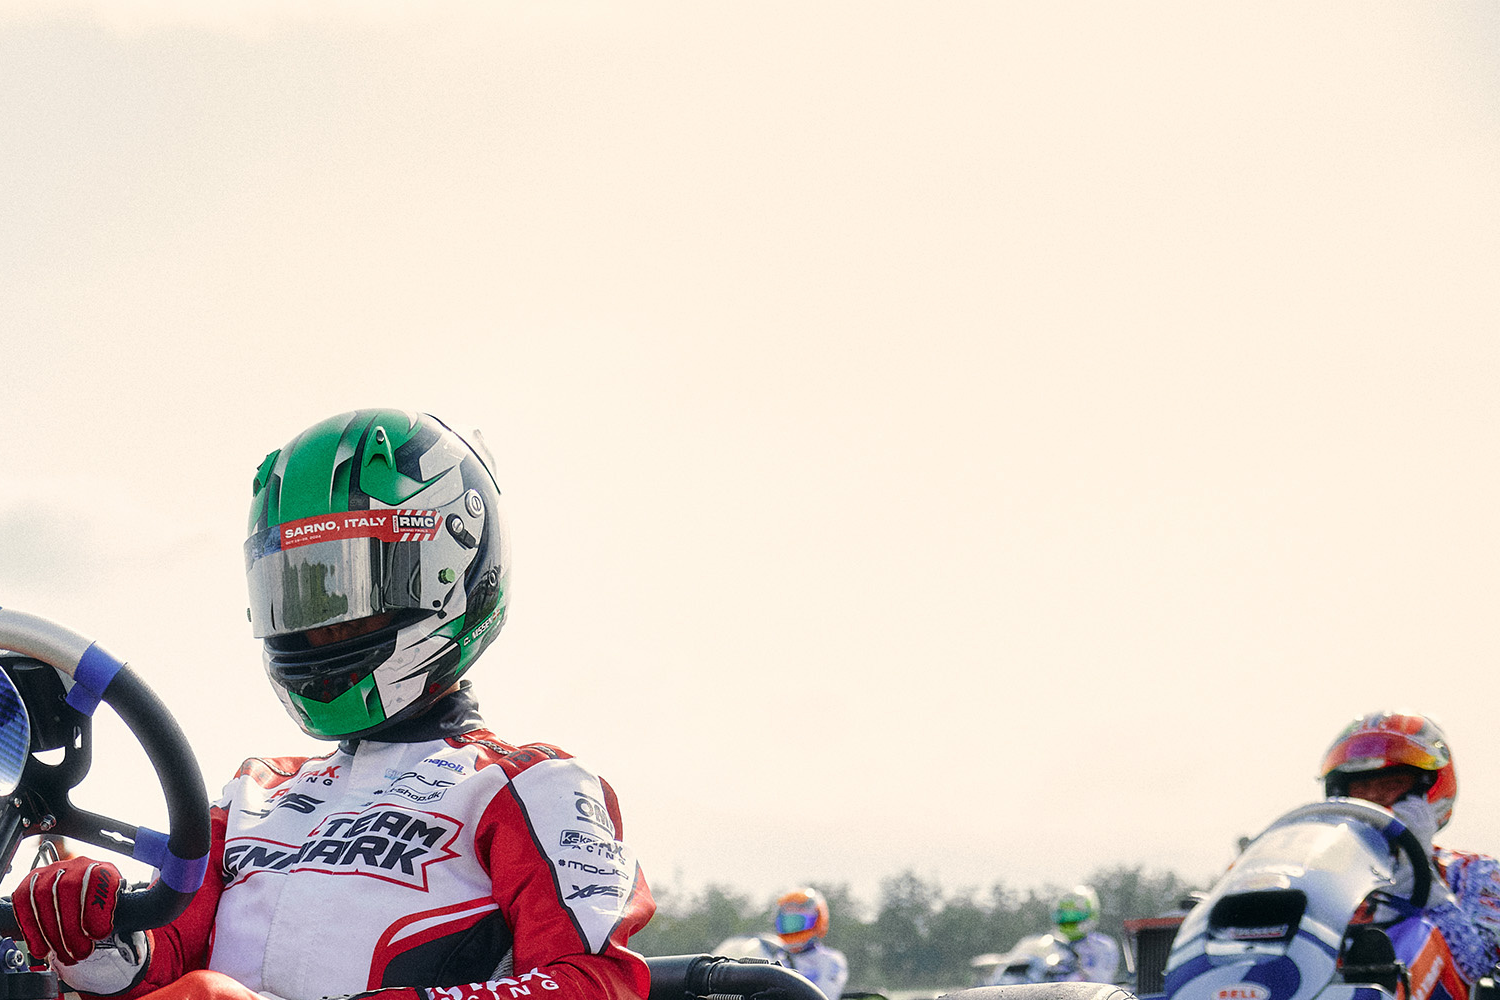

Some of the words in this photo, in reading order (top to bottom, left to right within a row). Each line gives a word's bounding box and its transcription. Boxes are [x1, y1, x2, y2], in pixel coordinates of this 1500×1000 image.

[285, 520, 341, 539] SARNO,
[344, 517, 387, 529] ITALY
[399, 516, 435, 528] RMC
[322, 811, 447, 849] TEAM
[1218, 990, 1259, 999] BELL
